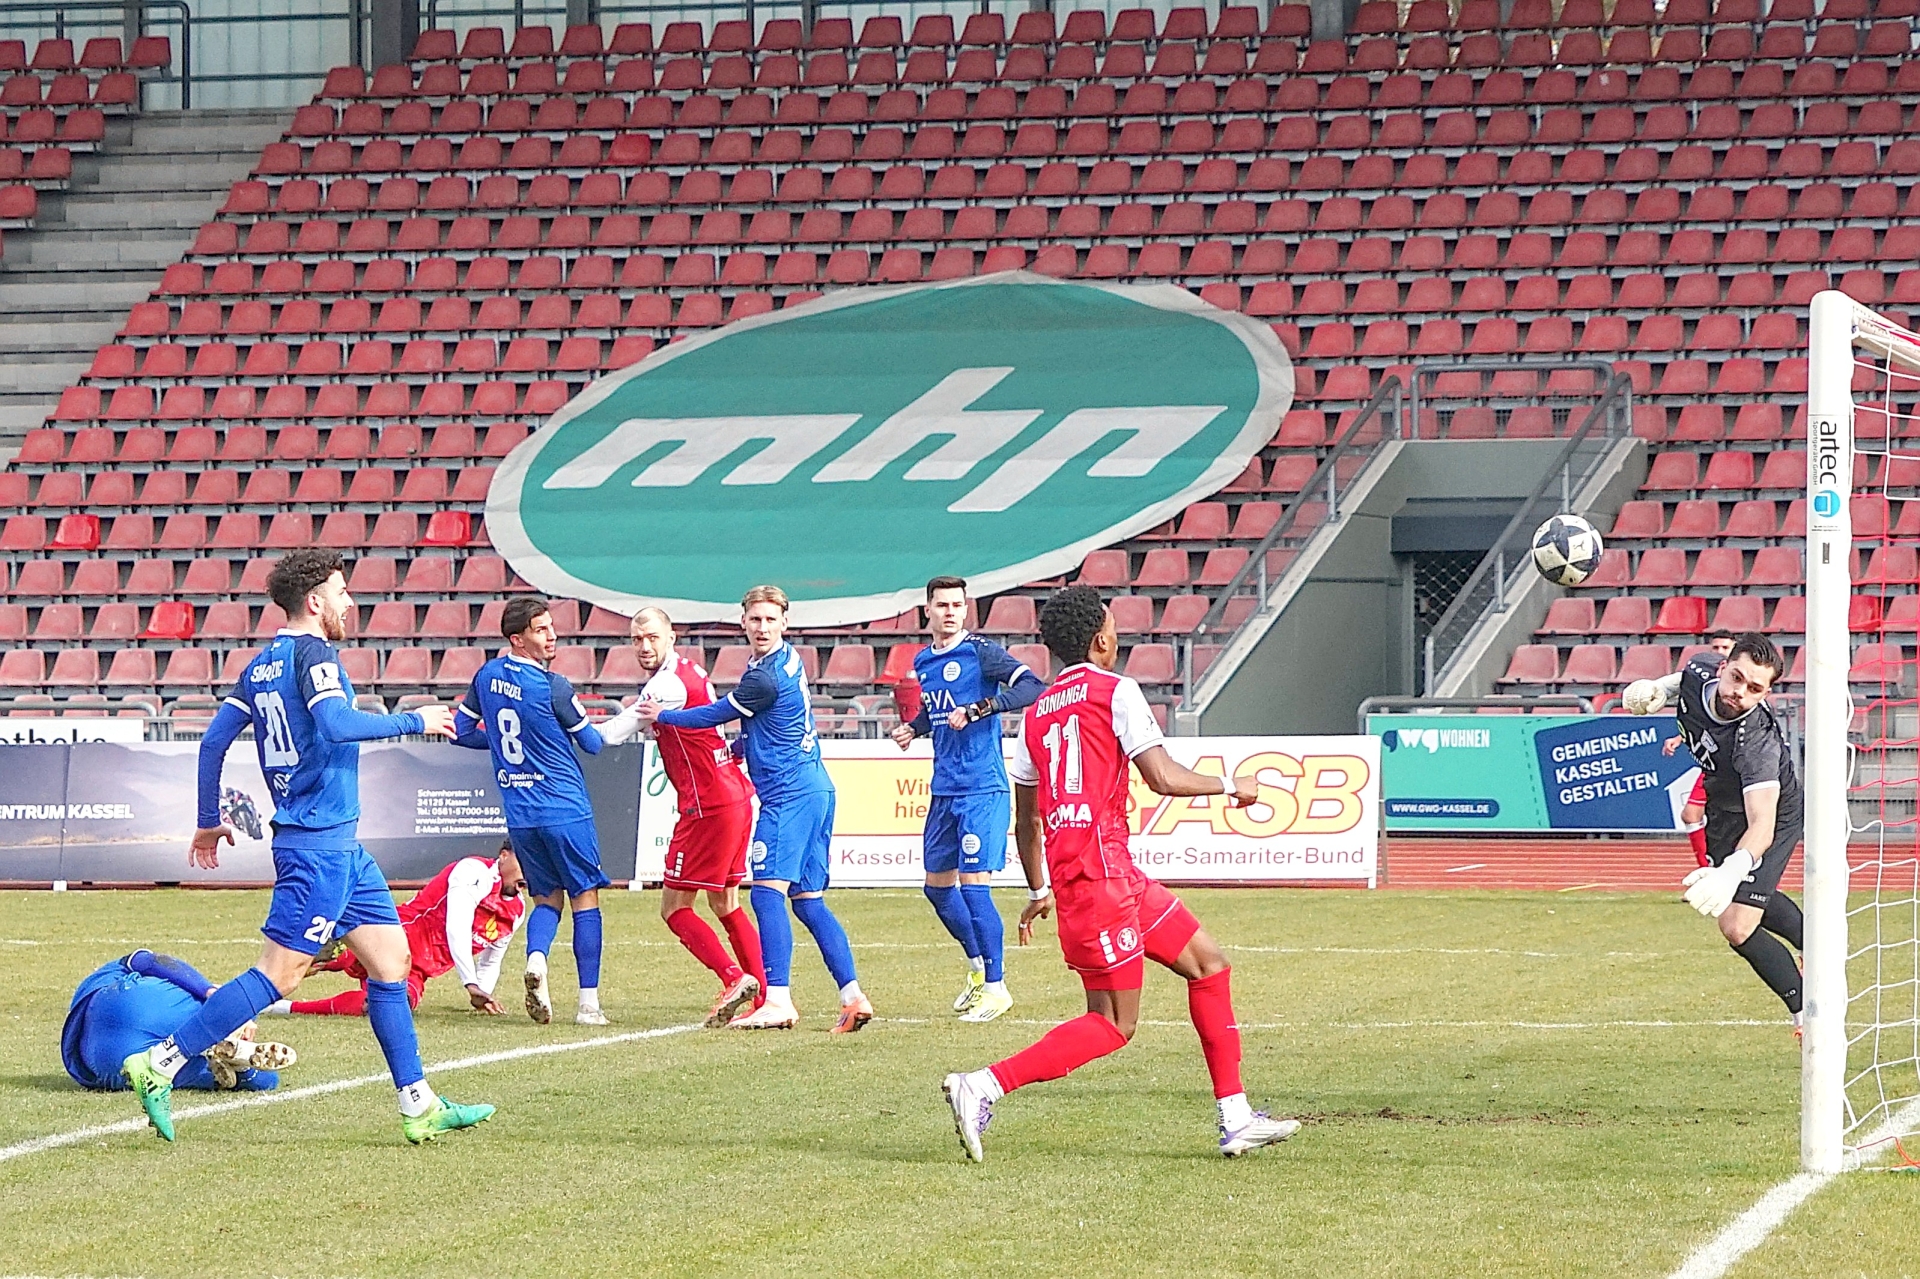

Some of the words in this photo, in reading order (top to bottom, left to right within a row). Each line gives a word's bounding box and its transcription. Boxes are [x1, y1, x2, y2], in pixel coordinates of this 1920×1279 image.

[542, 366, 1228, 512] mhp
[1820, 421, 1840, 485] artec
[1036, 683, 1088, 718] BONIANGA
[254, 690, 299, 768] 20
[497, 707, 525, 765] 8
[1440, 729, 1490, 748] WOHNEN
[1551, 727, 1658, 762] GEMEINSAM
[1042, 713, 1082, 800] 11
[1555, 757, 1623, 784] KASSEL
[445, 798, 469, 806] Kassel
[474, 789, 485, 797] 14
[1147, 751, 1371, 839] ASB
[1559, 771, 1659, 805] GESTALTEN
[0, 804, 65, 820] NTRUM
[68, 803, 134, 819] KASSEL
[304, 915, 337, 945] 20
